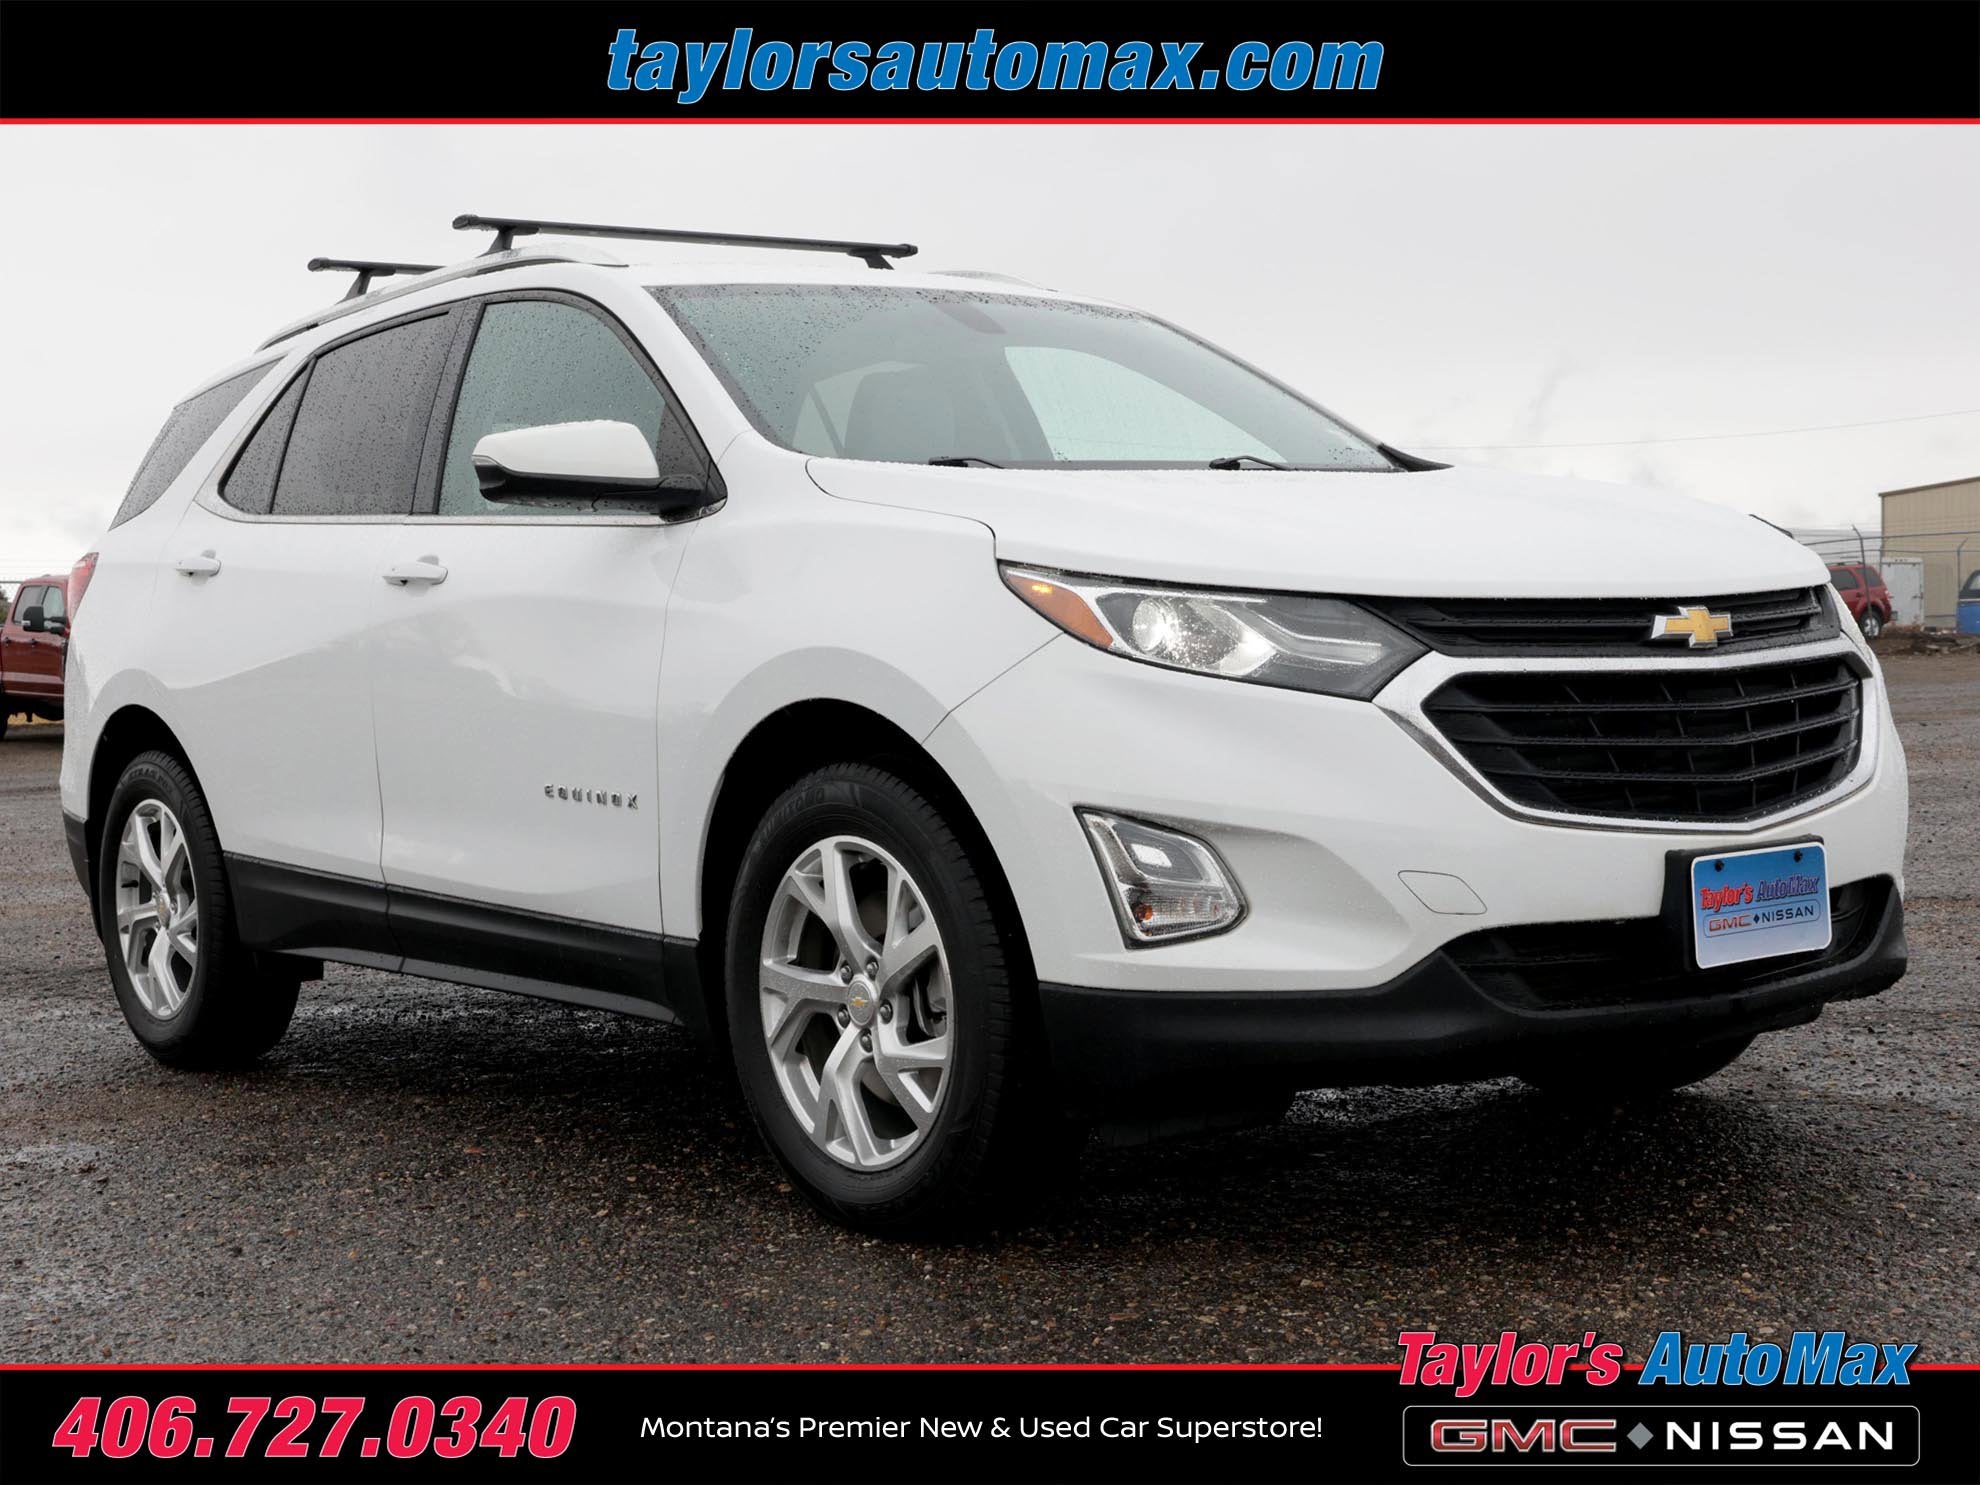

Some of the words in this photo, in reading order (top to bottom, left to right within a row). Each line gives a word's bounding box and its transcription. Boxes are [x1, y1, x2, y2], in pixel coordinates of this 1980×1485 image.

[544, 783, 639, 810] EQUINOX
[1700, 881, 1753, 913] Taylor's
[1756, 873, 1820, 901] AutoMax
[1708, 914, 1752, 932] GMC
[1761, 904, 1814, 924] NISSAN
